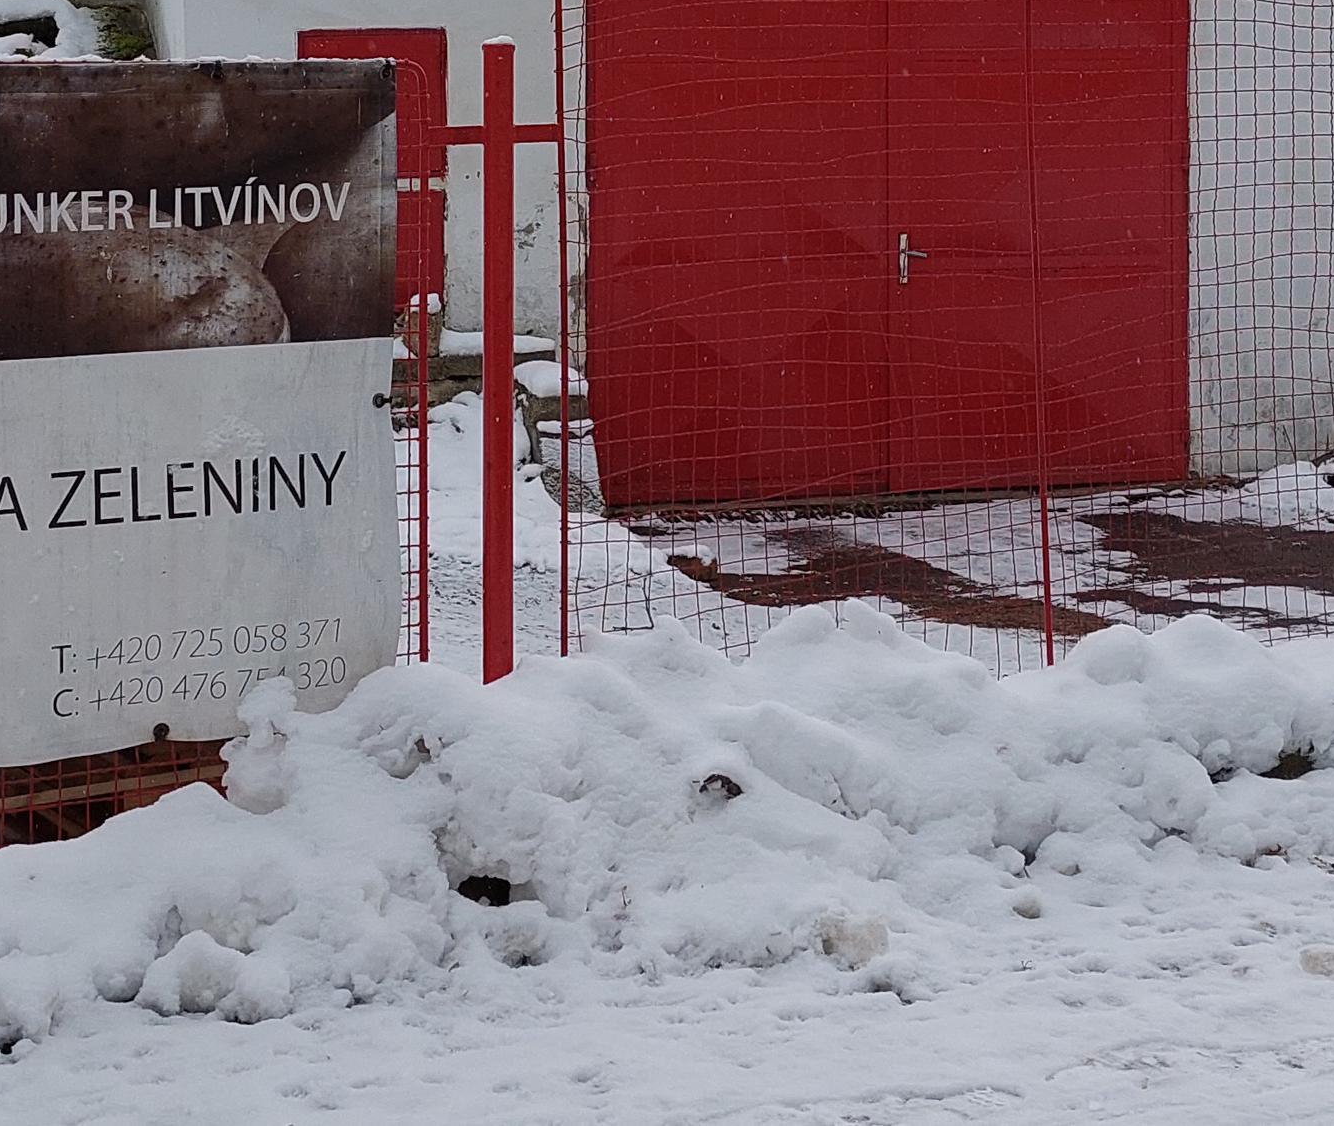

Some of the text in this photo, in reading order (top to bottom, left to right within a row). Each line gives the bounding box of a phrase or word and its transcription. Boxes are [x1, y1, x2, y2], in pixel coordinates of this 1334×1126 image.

[148, 176, 352, 230] LITVÍNOV
[48, 450, 348, 530] ZELENINY
[50, 617, 342, 675] T: +420 725 058 371
[52, 687, 80, 718] C:
[88, 675, 165, 712] +420
[170, 670, 228, 701] 476
[296, 656, 347, 690] 320
